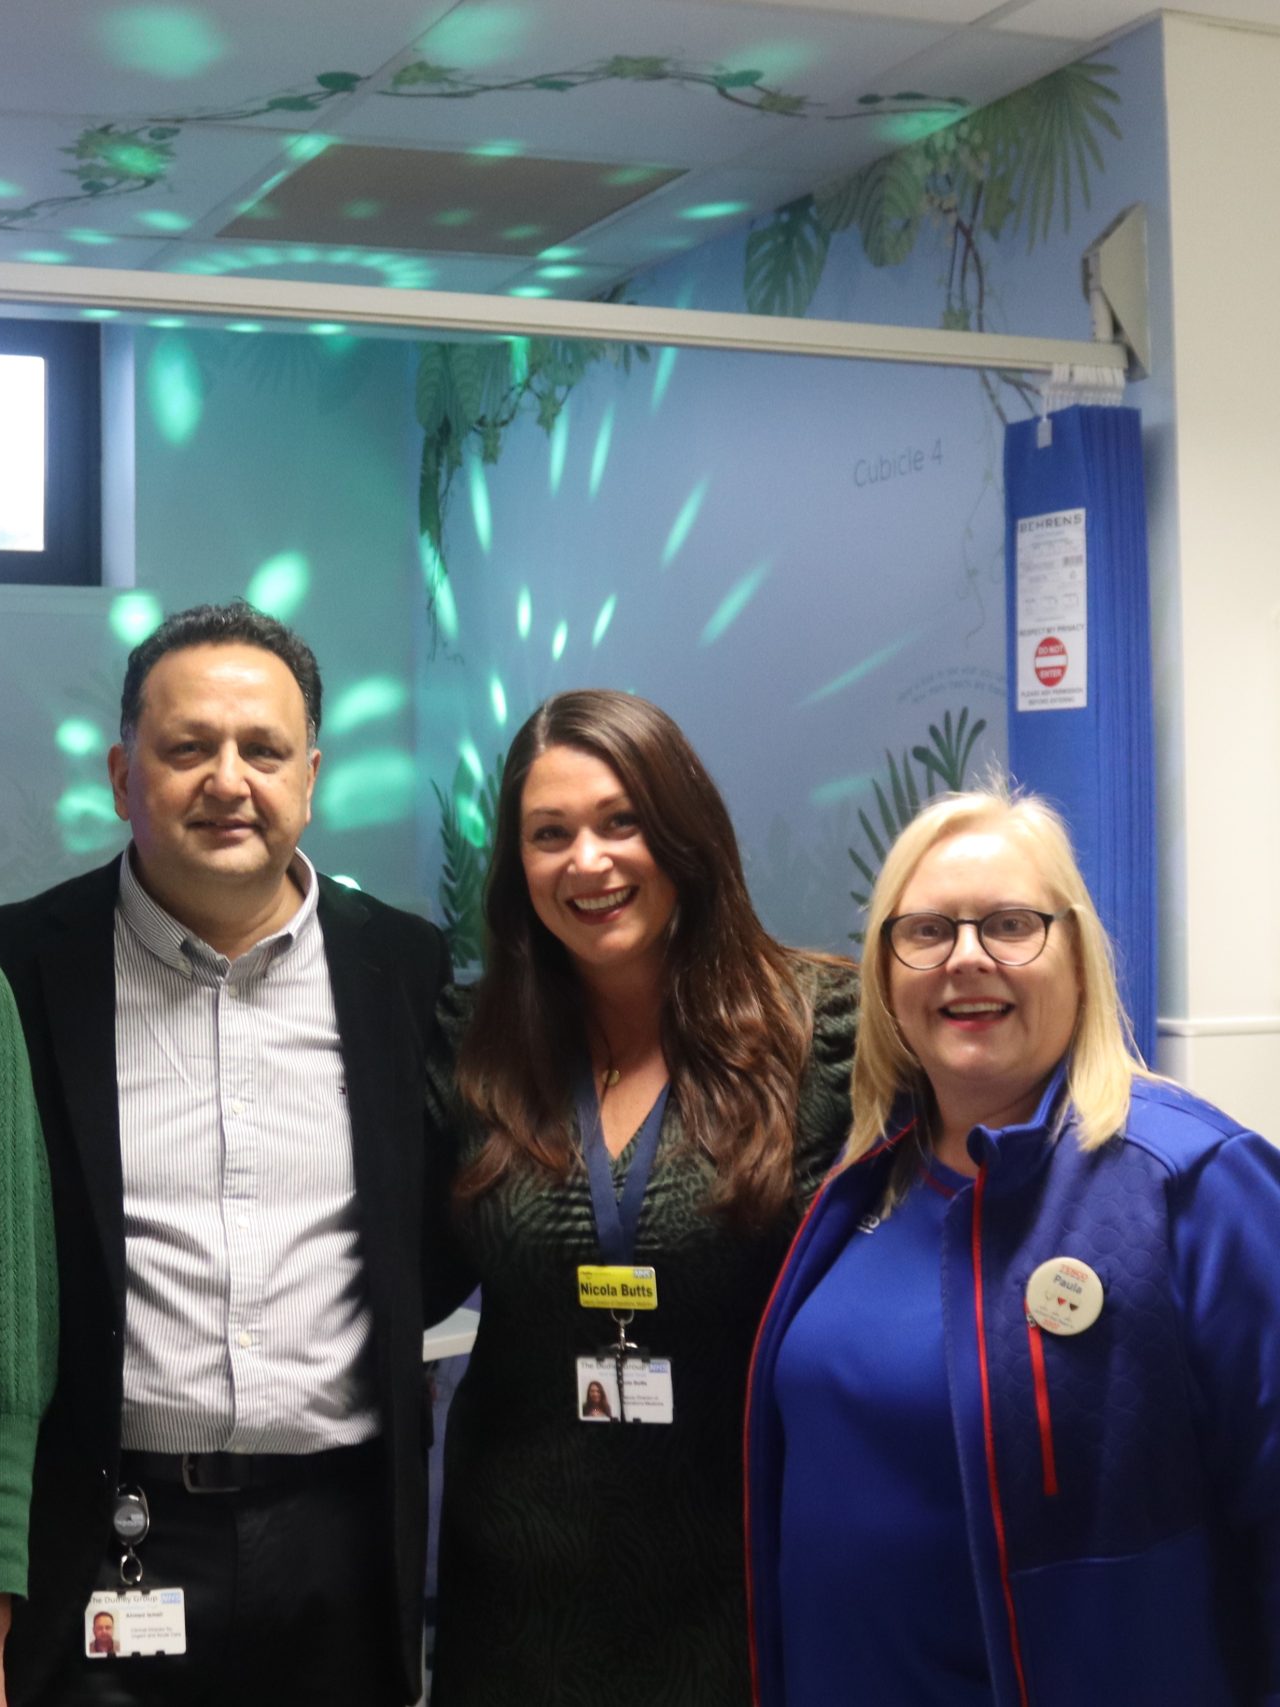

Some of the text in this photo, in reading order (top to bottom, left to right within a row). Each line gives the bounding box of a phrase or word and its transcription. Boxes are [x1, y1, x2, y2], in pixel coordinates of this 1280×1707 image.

[854, 437, 943, 488] Cubicle 4
[1019, 512, 1083, 534] BEHRENS
[580, 1283, 653, 1298] Nicola Butts
[1053, 1274, 1083, 1295] Paula
